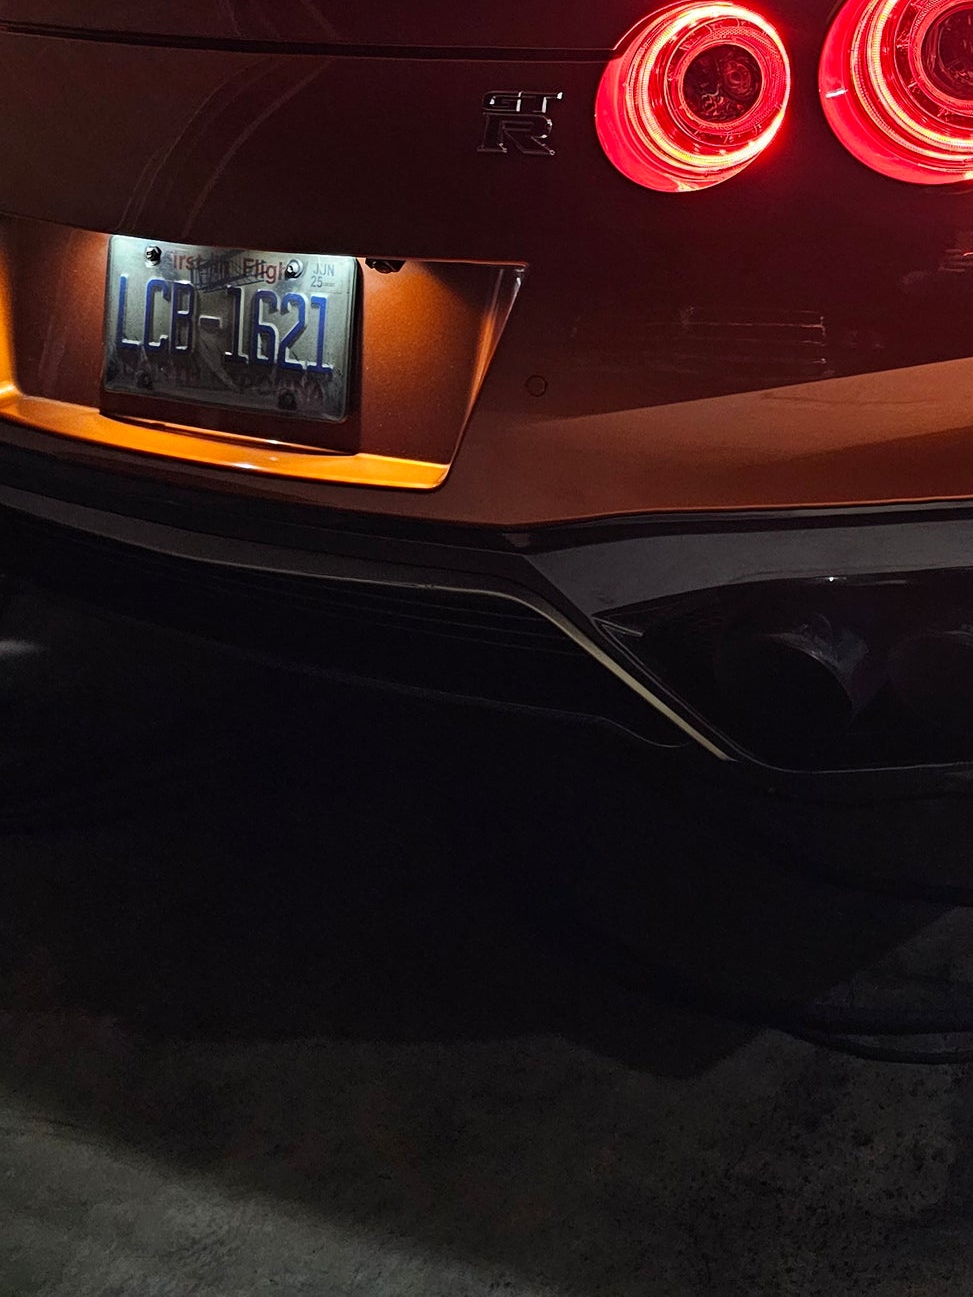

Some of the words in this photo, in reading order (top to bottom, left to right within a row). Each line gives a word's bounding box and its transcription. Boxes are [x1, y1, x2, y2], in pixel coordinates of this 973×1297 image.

[313, 262, 335, 277] JUN
[310, 274, 323, 288] 25
[116, 274, 334, 375] LCB-1621
